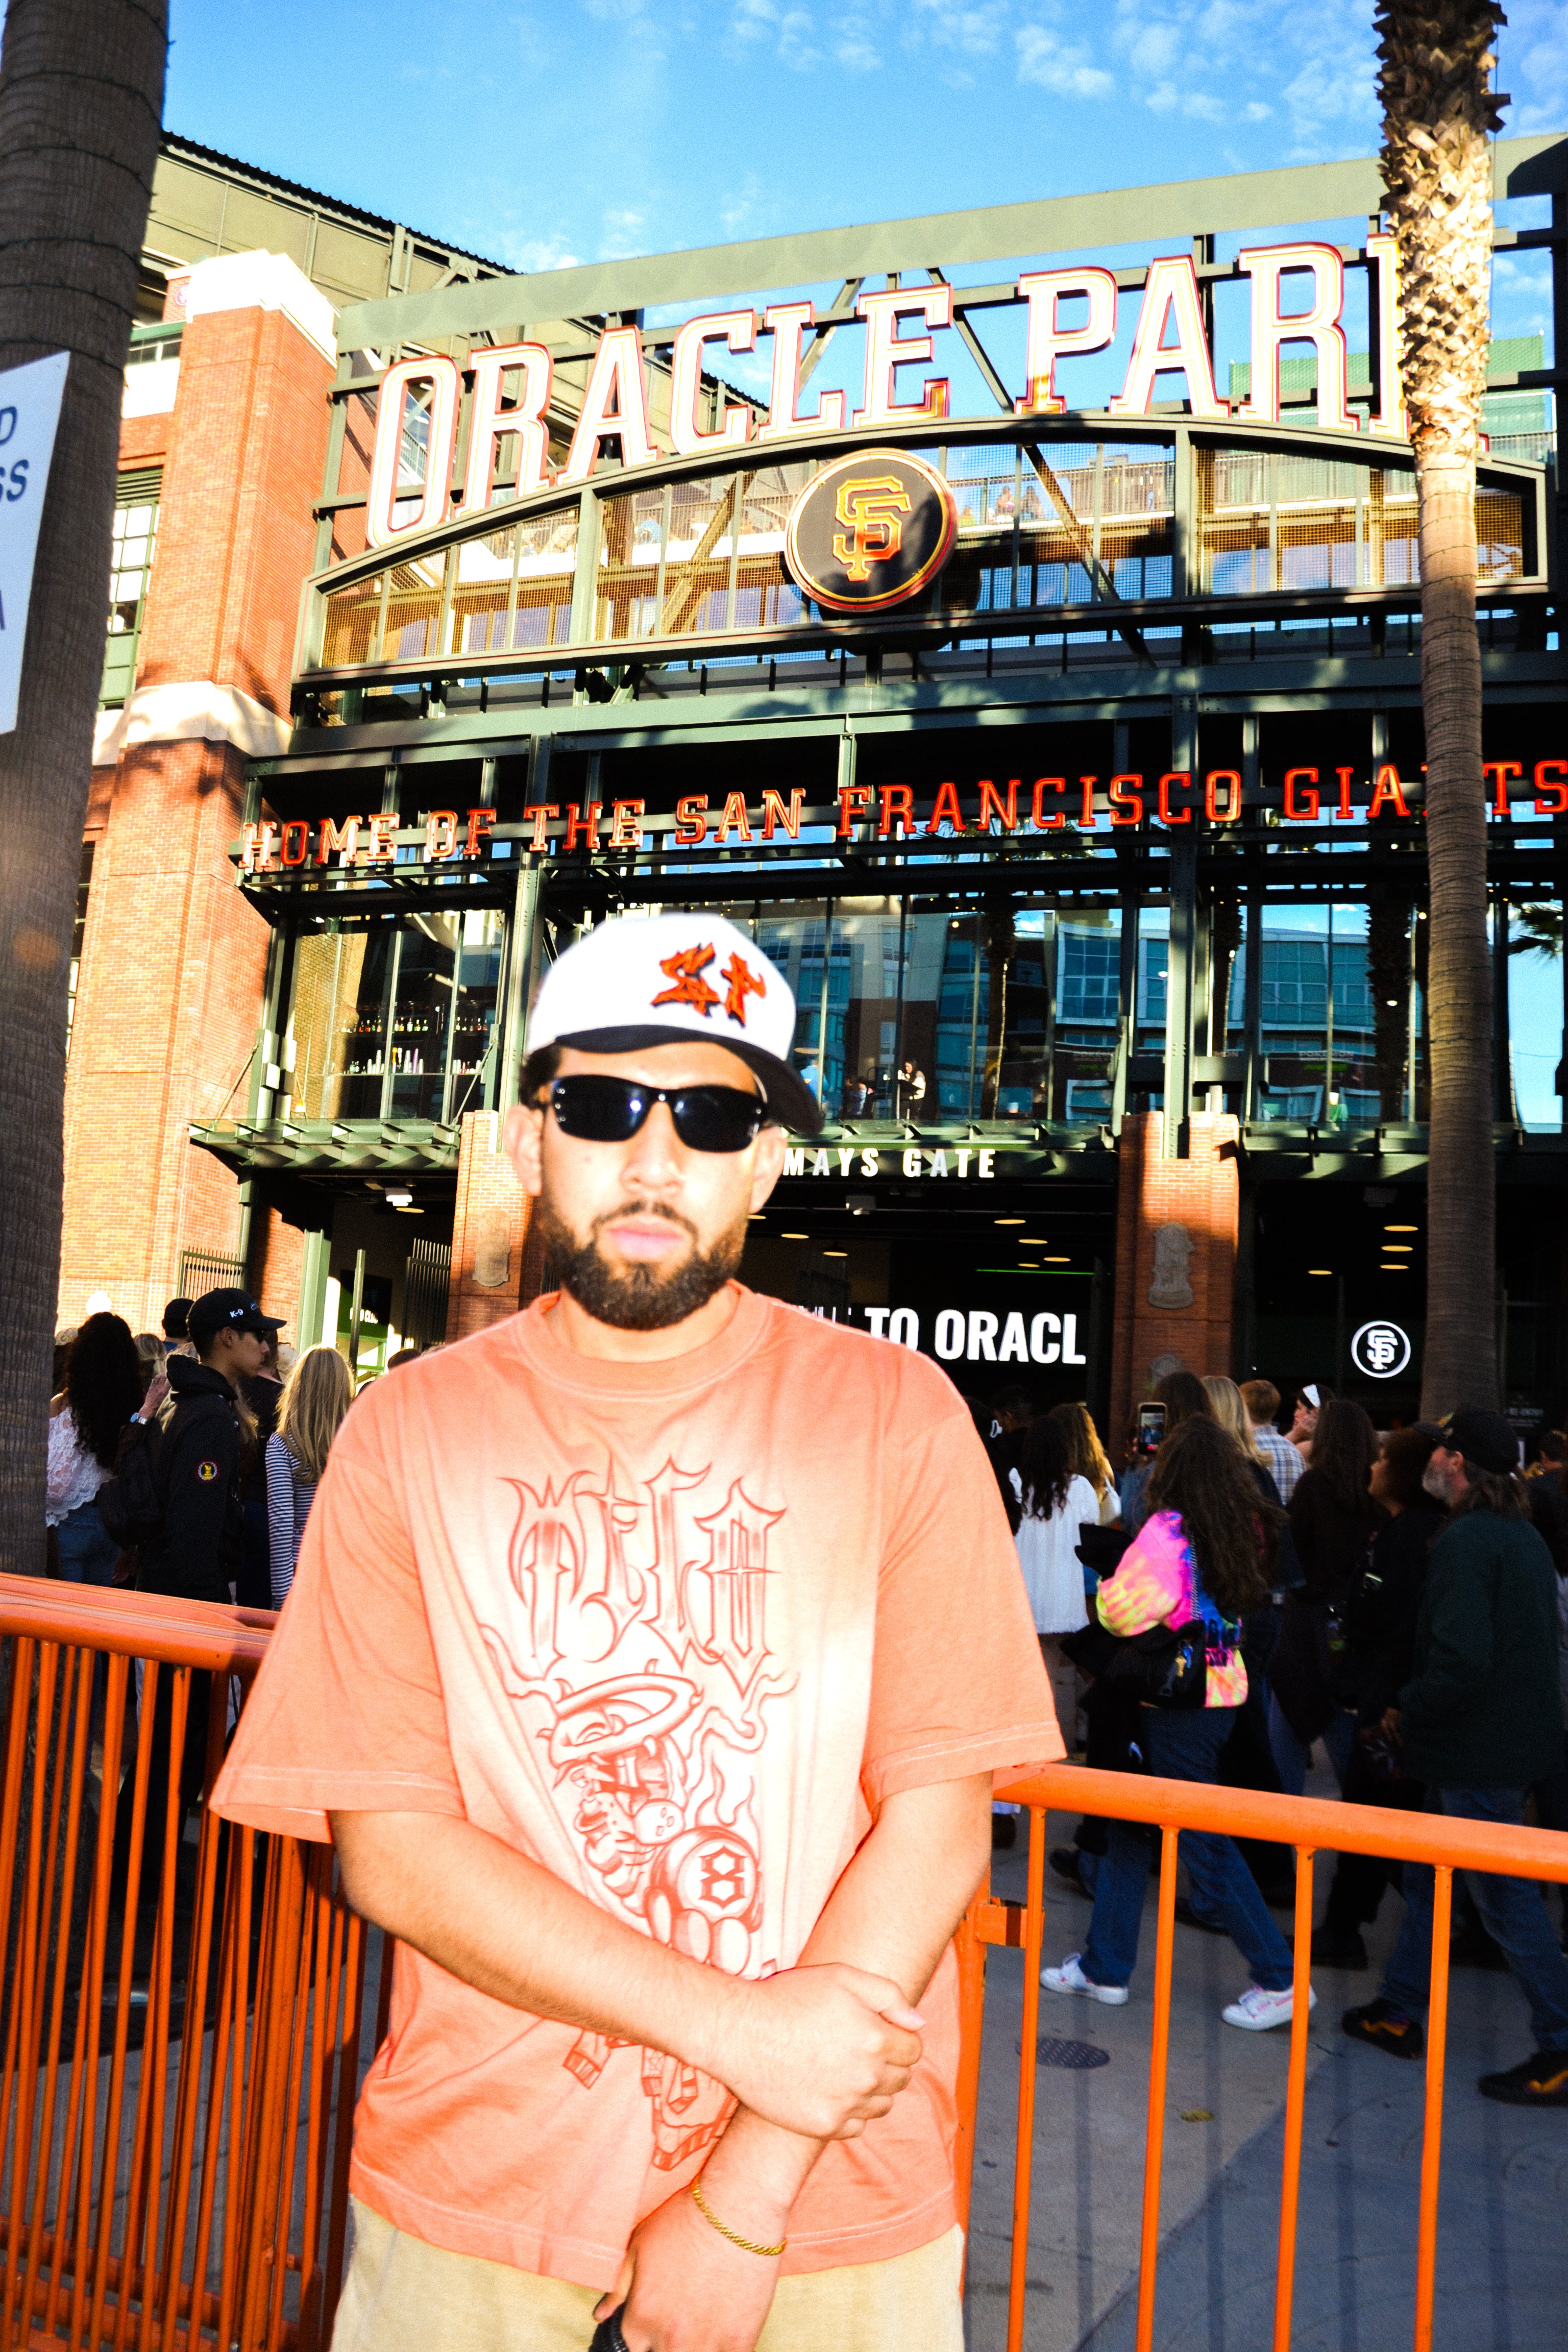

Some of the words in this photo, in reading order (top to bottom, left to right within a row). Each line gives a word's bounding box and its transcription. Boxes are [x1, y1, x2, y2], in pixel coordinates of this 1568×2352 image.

[367, 283, 953, 548] ORACLE
[1015, 232, 1489, 453] PAR
[832, 475, 913, 581] SF
[238, 812, 400, 871] HOME
[427, 807, 497, 857] OF
[524, 798, 645, 852] THE
[675, 788, 806, 845] SAN
[838, 770, 1242, 836] FRANCISCO
[1284, 760, 1568, 820] GIATS
[783, 1147, 879, 1177] MAYS
[903, 1148, 995, 1178] GATE
[230, 1309, 243, 1318] K-9
[865, 1307, 919, 1351] TO
[935, 1309, 1086, 1364] ORACL
[1367, 1329, 1399, 1370] SF
[699, 1846, 747, 1909] 8
